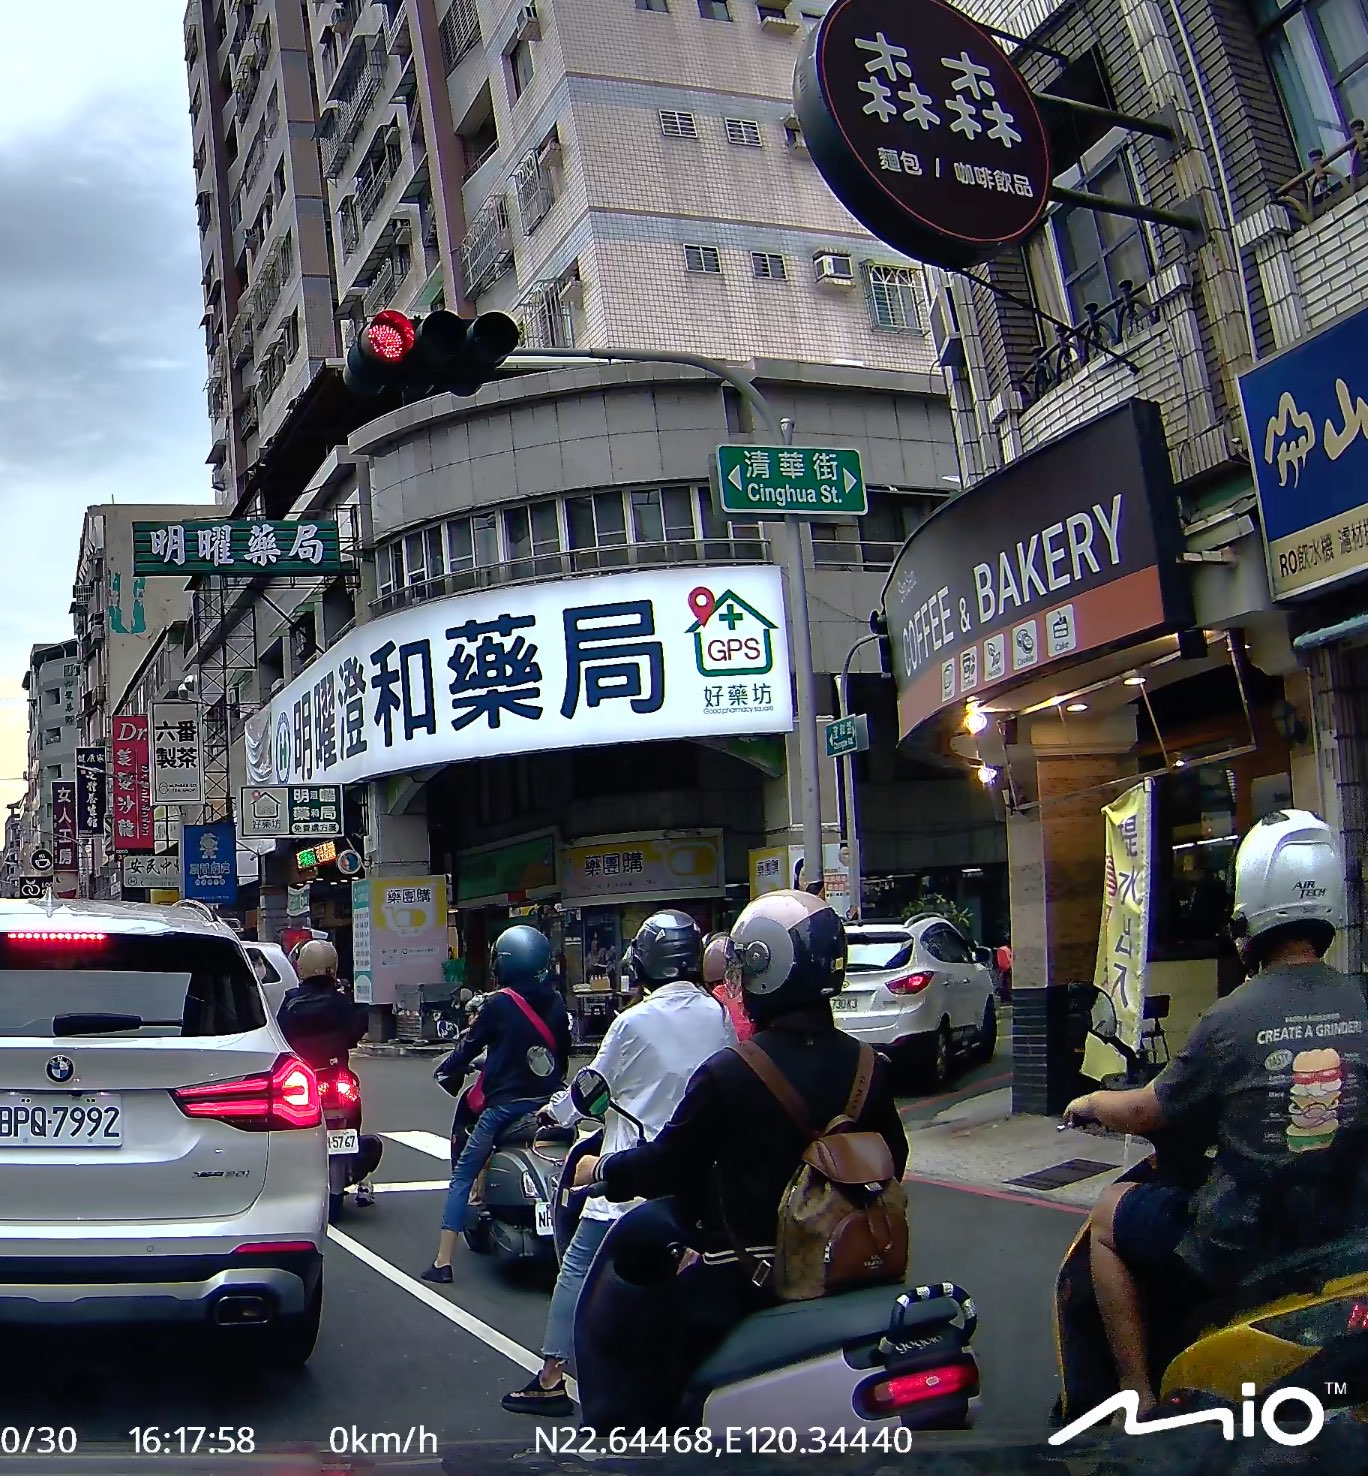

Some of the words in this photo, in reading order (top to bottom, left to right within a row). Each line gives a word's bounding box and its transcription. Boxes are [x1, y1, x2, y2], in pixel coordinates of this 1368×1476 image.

[854, 31, 1022, 149] 森森
[877, 146, 923, 176] 麵包
[954, 161, 1034, 198] 咖啡飲品
[743, 450, 838, 481] 清華街
[747, 482, 817, 507] Cinghua
[820, 484, 843, 504] St.
[149, 523, 325, 567] 明曜藥局
[903, 586, 954, 677] COFFEE
[959, 597, 971, 633] &
[973, 494, 1122, 624] BAKERY
[707, 637, 761, 662] GPS
[292, 598, 665, 784] 明曜澄和藥局
[703, 682, 773, 708] 好藥坊
[117, 722, 148, 742] Dr.
[154, 719, 197, 743] 六番
[155, 746, 198, 769] 製茶
[584, 852, 644, 877] 藥團購
[387, 888, 432, 904] 藥團購
[1256, 1025, 1302, 1045] CREATE
[1304, 1024, 1314, 1038] A
